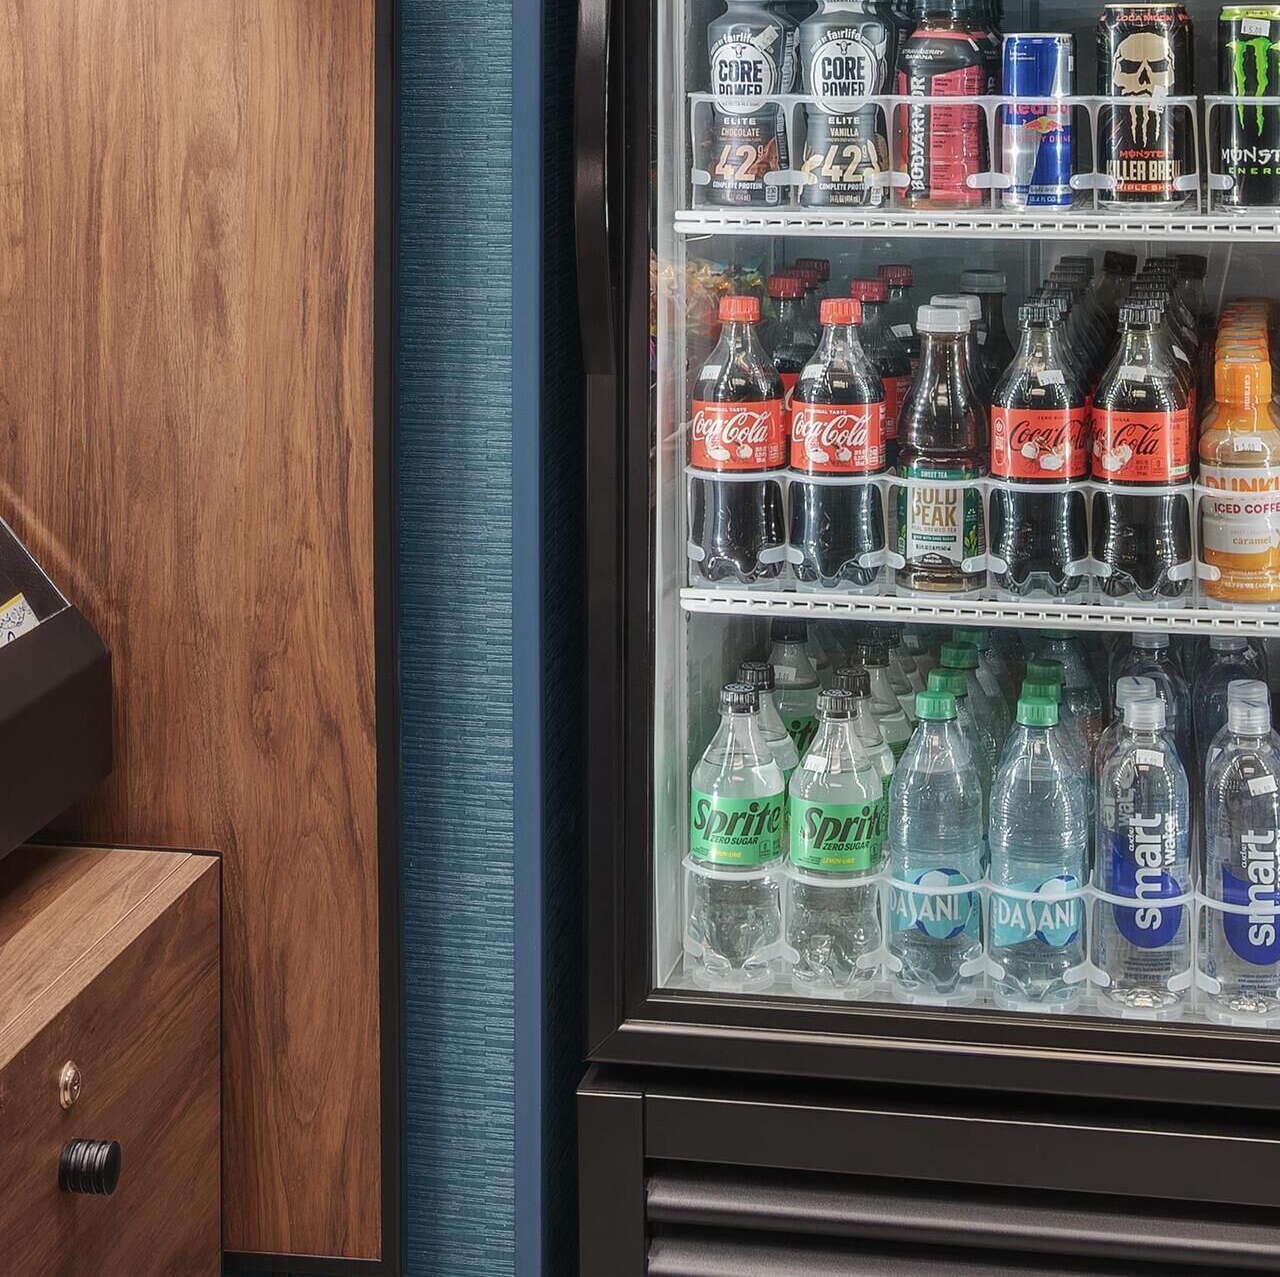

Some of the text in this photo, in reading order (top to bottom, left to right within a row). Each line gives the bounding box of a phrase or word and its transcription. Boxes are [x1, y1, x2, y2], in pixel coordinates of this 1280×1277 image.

[719, 59, 763, 83] CORE
[821, 56, 866, 81] CORE
[724, 117, 757, 125] ELITE
[827, 116, 861, 125] ELITE
[721, 127, 761, 137] CHOCOLATE
[829, 127, 860, 137] VANILLA
[1214, 502, 1242, 514] ICED
[911, 506, 957, 526] PEAK
[694, 799, 780, 839] Sprite
[710, 835, 759, 845] ZERO SUGAR
[822, 840, 870, 851] ZERO SUGAR
[1165, 816, 1177, 865] water
[998, 893, 1077, 938] DASANI
